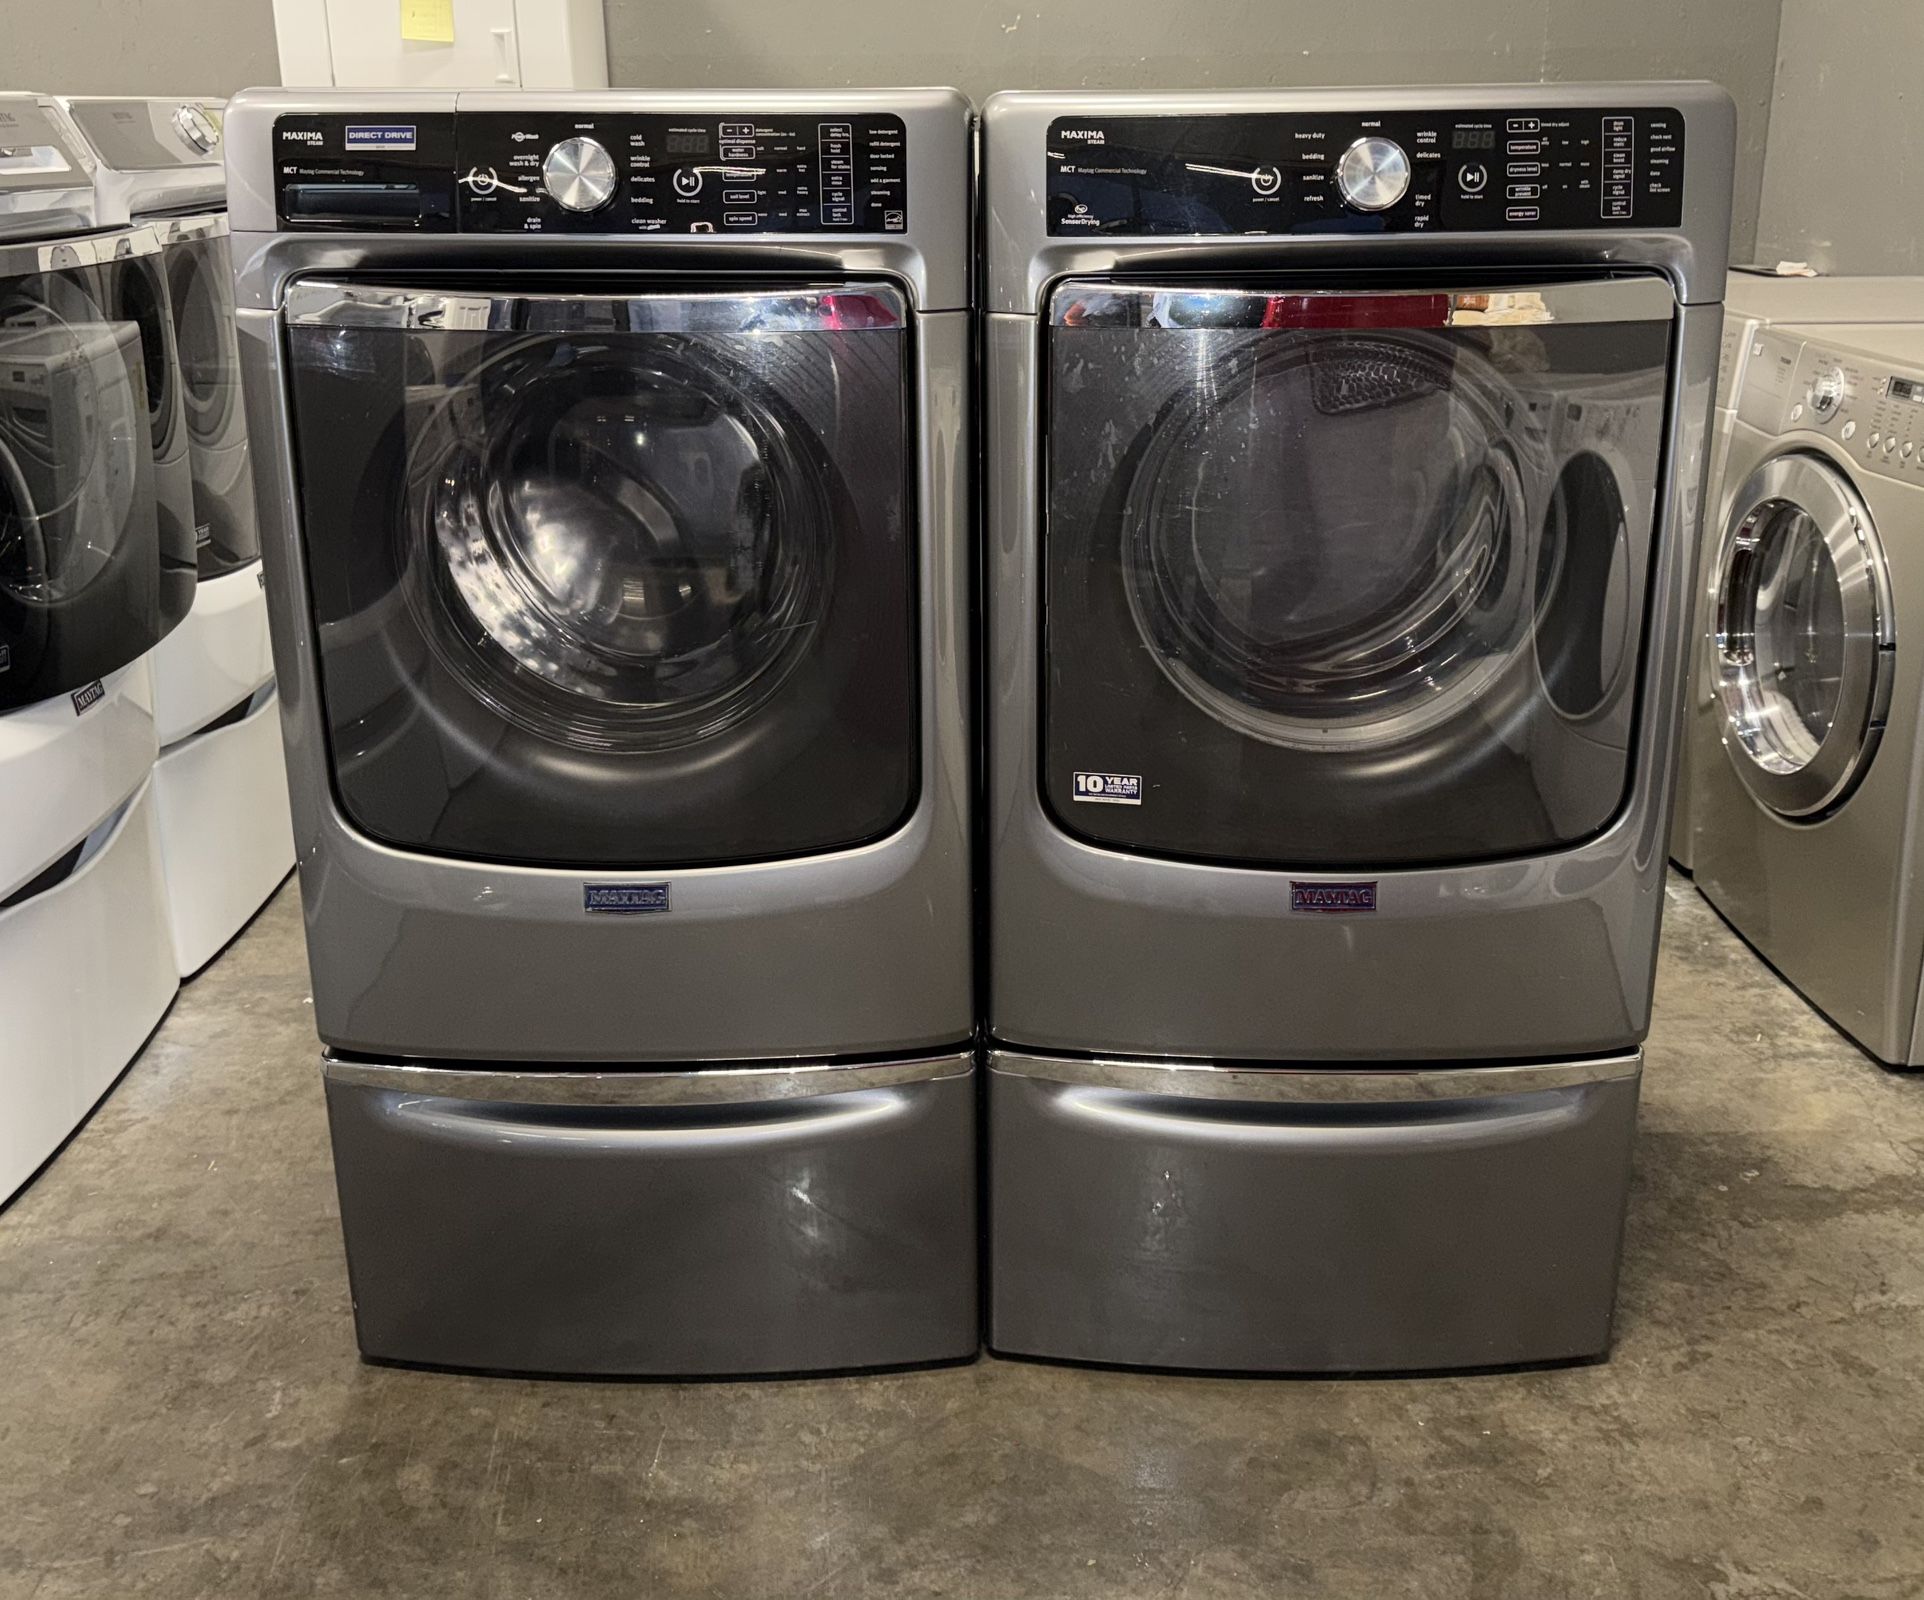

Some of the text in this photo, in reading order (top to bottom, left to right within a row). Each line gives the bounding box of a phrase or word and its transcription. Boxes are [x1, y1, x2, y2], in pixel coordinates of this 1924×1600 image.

[282, 131, 323, 140] MAXIMA
[349, 131, 413, 139] DIRECT DRIVE
[1061, 130, 1105, 139] MAXIMA
[283, 166, 298, 174] MCT
[1060, 165, 1076, 173] MCT
[77, 682, 104, 709] MAYTAG
[1077, 775, 1104, 793] 10
[1105, 776, 1138, 786] YEAR
[588, 889, 667, 905] MAYTAG
[1295, 889, 1373, 903] MAYTAG
